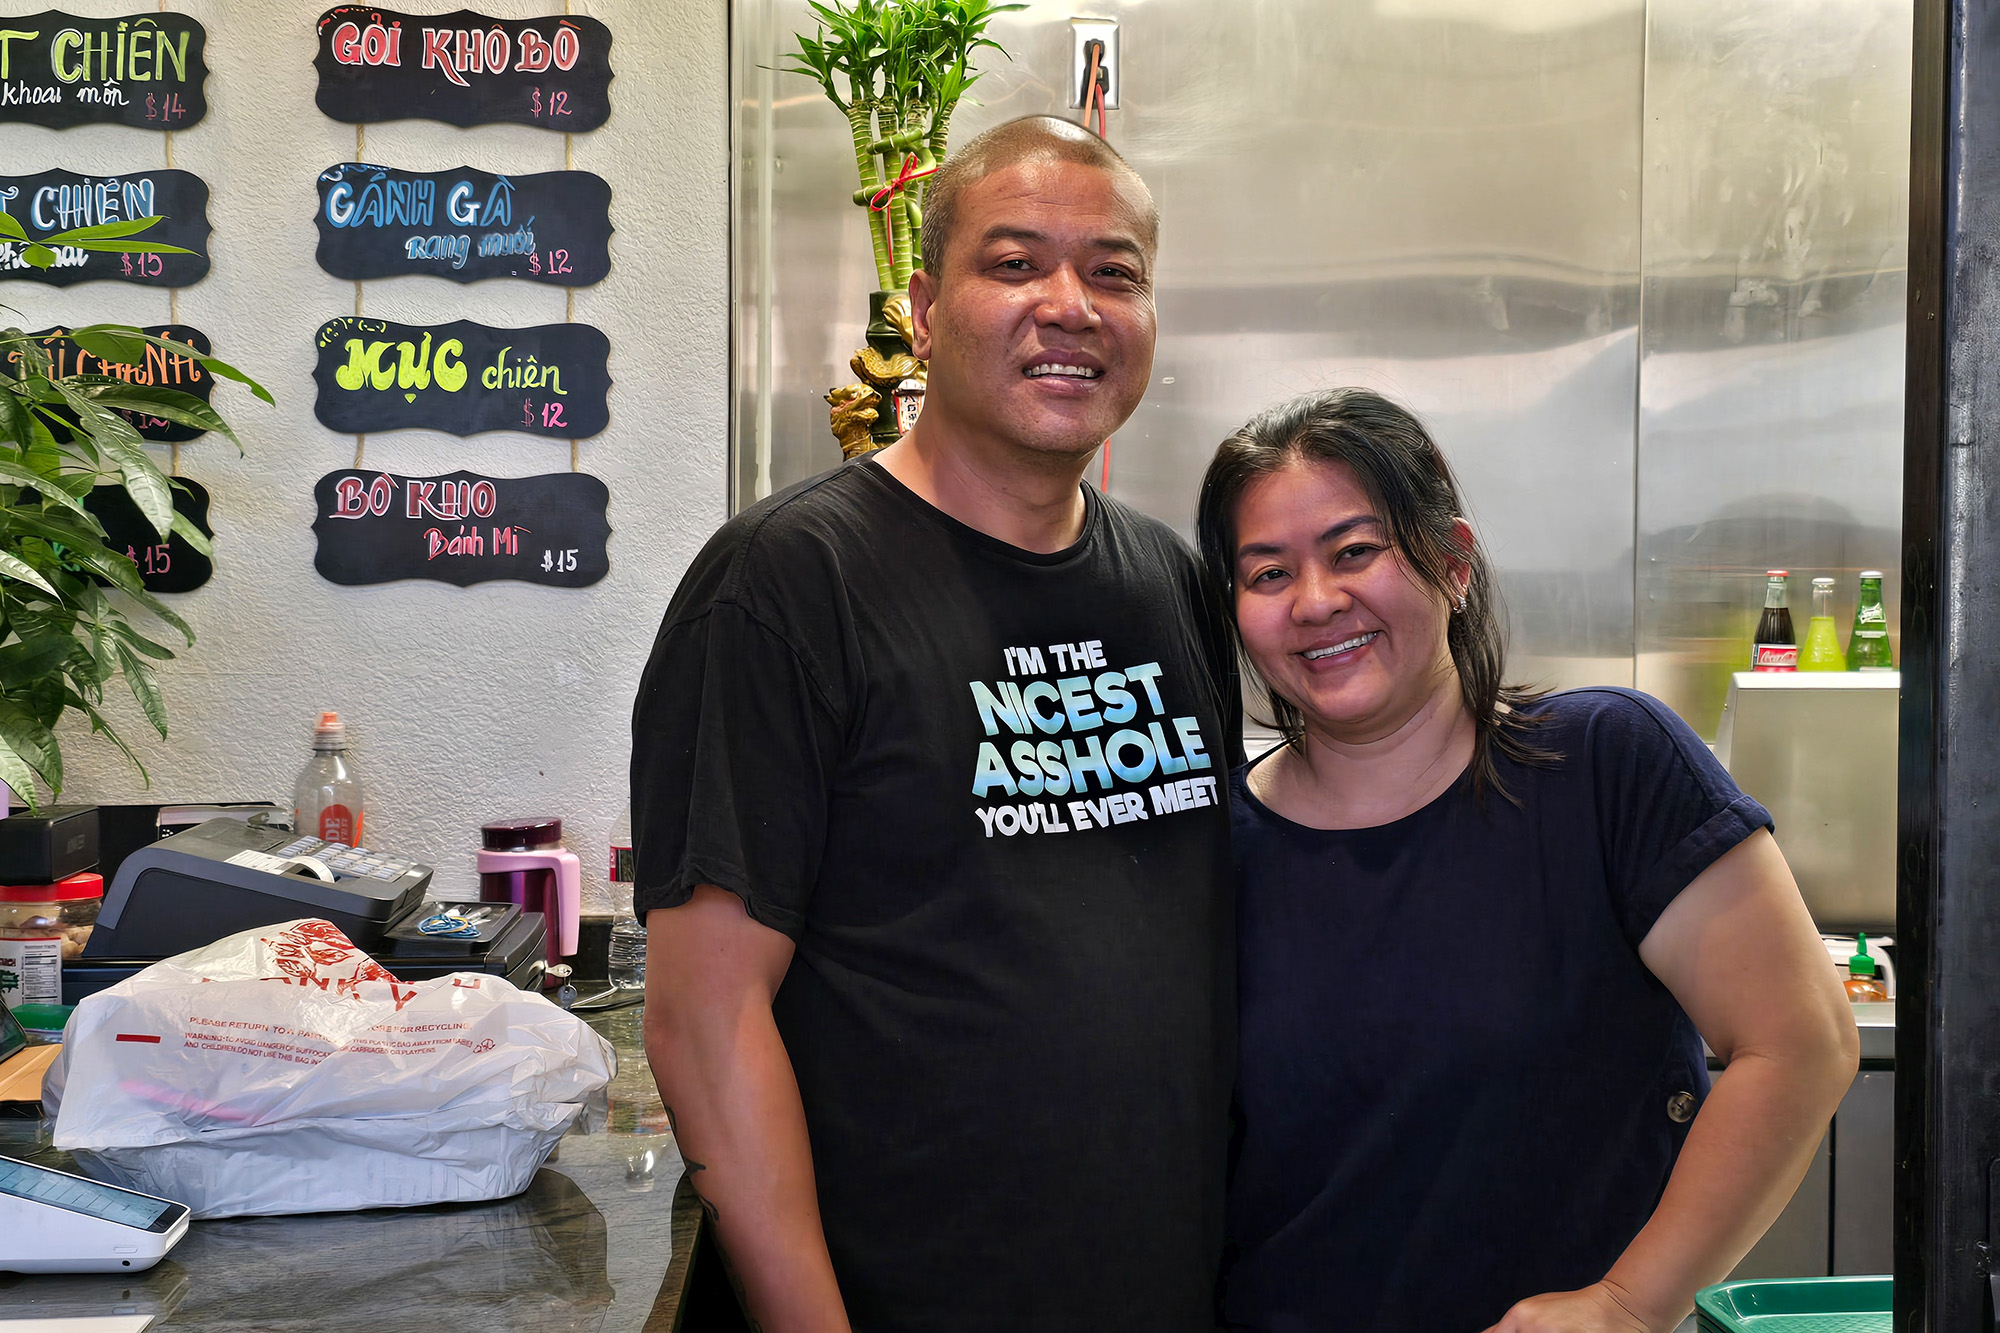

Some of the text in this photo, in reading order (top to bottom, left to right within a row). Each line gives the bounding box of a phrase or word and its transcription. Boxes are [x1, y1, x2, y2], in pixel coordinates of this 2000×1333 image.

[421, 24, 512, 87] KHÔ
[514, 19, 582, 72] BÒ
[76, 78, 130, 107] môn
[446, 175, 516, 227] GÀ
[335, 331, 568, 404] MỰC chiên
[328, 472, 497, 521] BÒ KHO
[540, 548, 579, 573] $15
[1003, 640, 1107, 676] I'M THE
[969, 662, 1165, 736] NICEST
[971, 716, 1212, 798] ASSHOLE
[974, 776, 1219, 838] YOU'LL EVER MEET
[183, 1041, 200, 1049] AND
[247, 1049, 263, 1058] NOT
[189, 1016, 228, 1028] PLEASE
[228, 1020, 269, 1032] RETURN
[272, 1025, 286, 1035] TO
